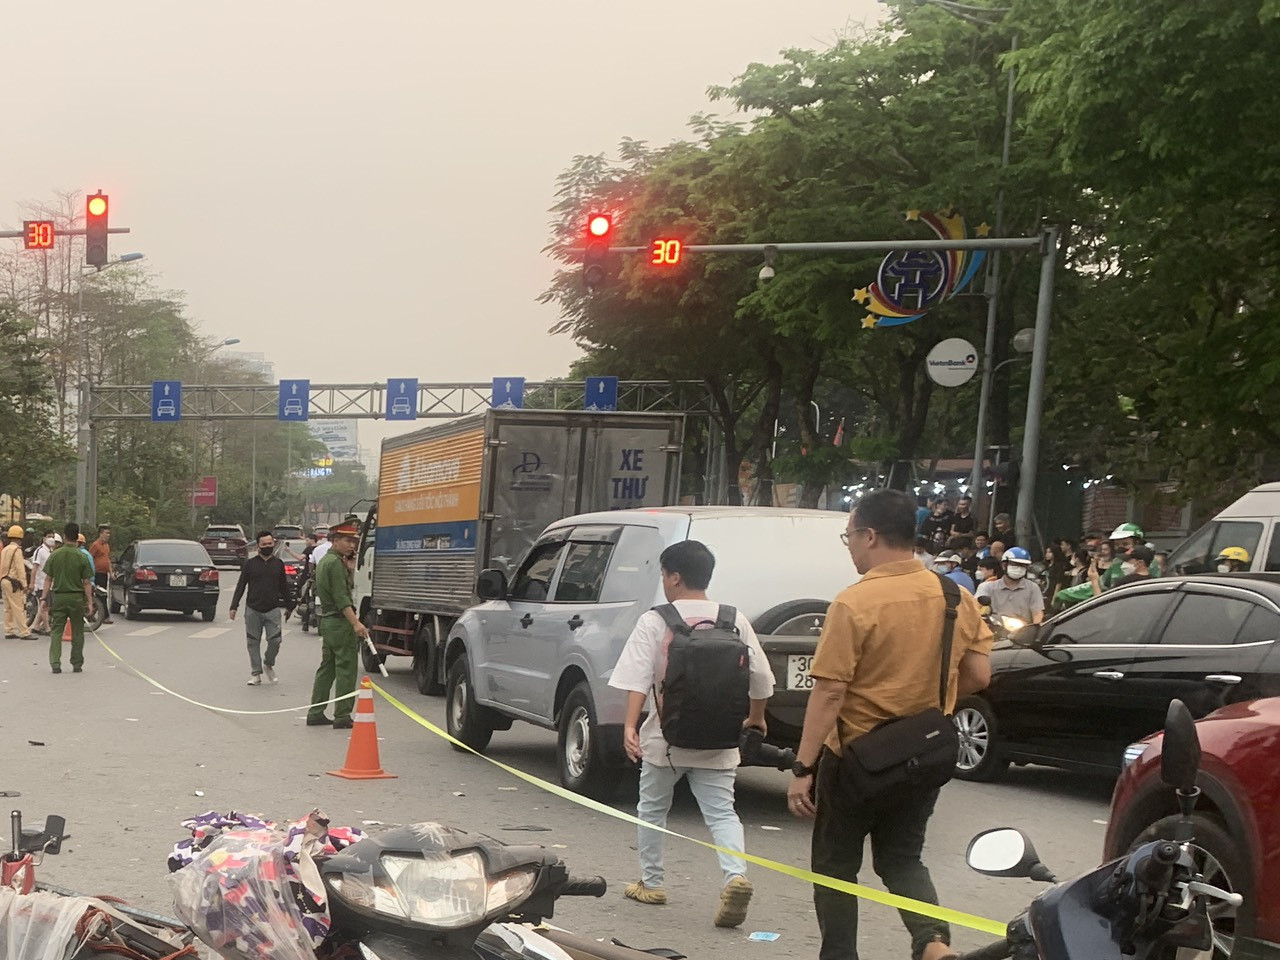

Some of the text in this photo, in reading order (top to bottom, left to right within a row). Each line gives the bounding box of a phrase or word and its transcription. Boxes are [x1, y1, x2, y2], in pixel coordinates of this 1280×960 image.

[28, 223, 51, 246] 30
[652, 240, 680, 264] 30
[620, 449, 644, 471] XE
[612, 475, 649, 499] THƯ
